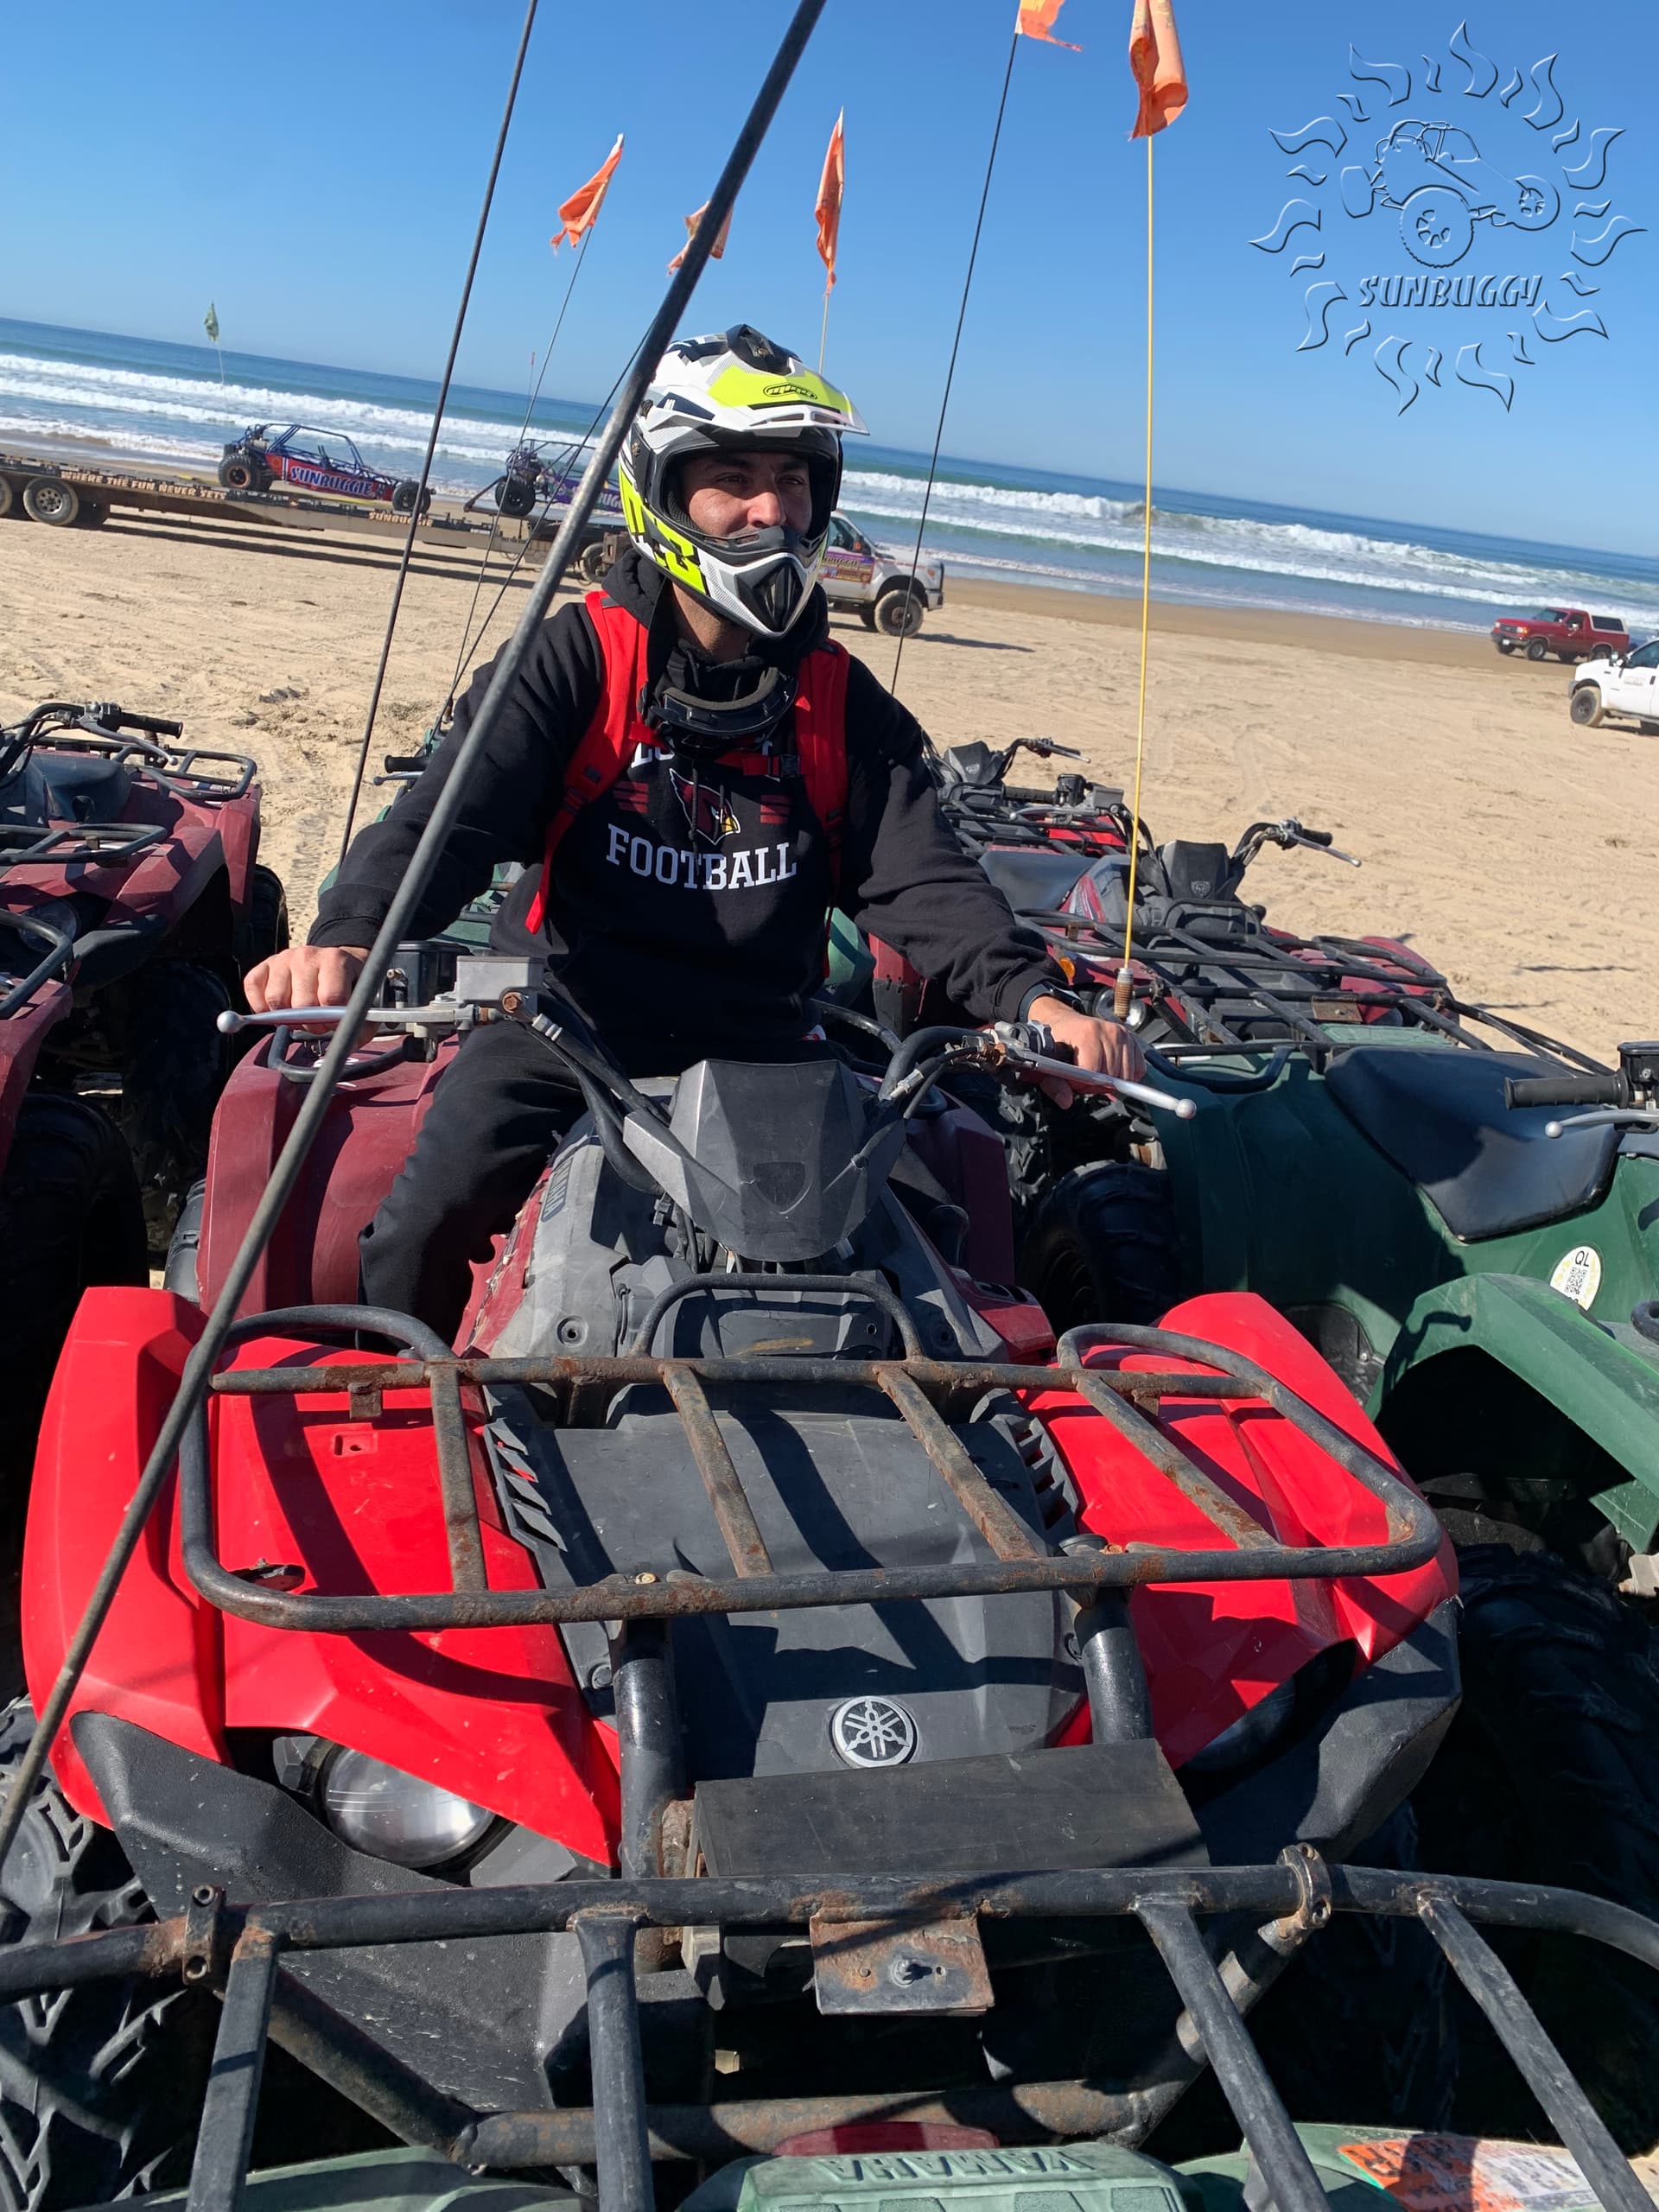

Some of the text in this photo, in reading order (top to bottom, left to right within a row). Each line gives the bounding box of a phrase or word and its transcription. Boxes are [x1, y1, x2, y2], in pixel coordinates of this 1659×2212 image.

[60, 471, 227, 500] WHERE THE FUN NEVER SETS
[290, 467, 373, 497] SUNBUGGIE
[606, 823, 797, 891] FOOTBALL
[1574, 1250, 1590, 1268] QL
[815, 2151, 1096, 2182] YAMAHA
